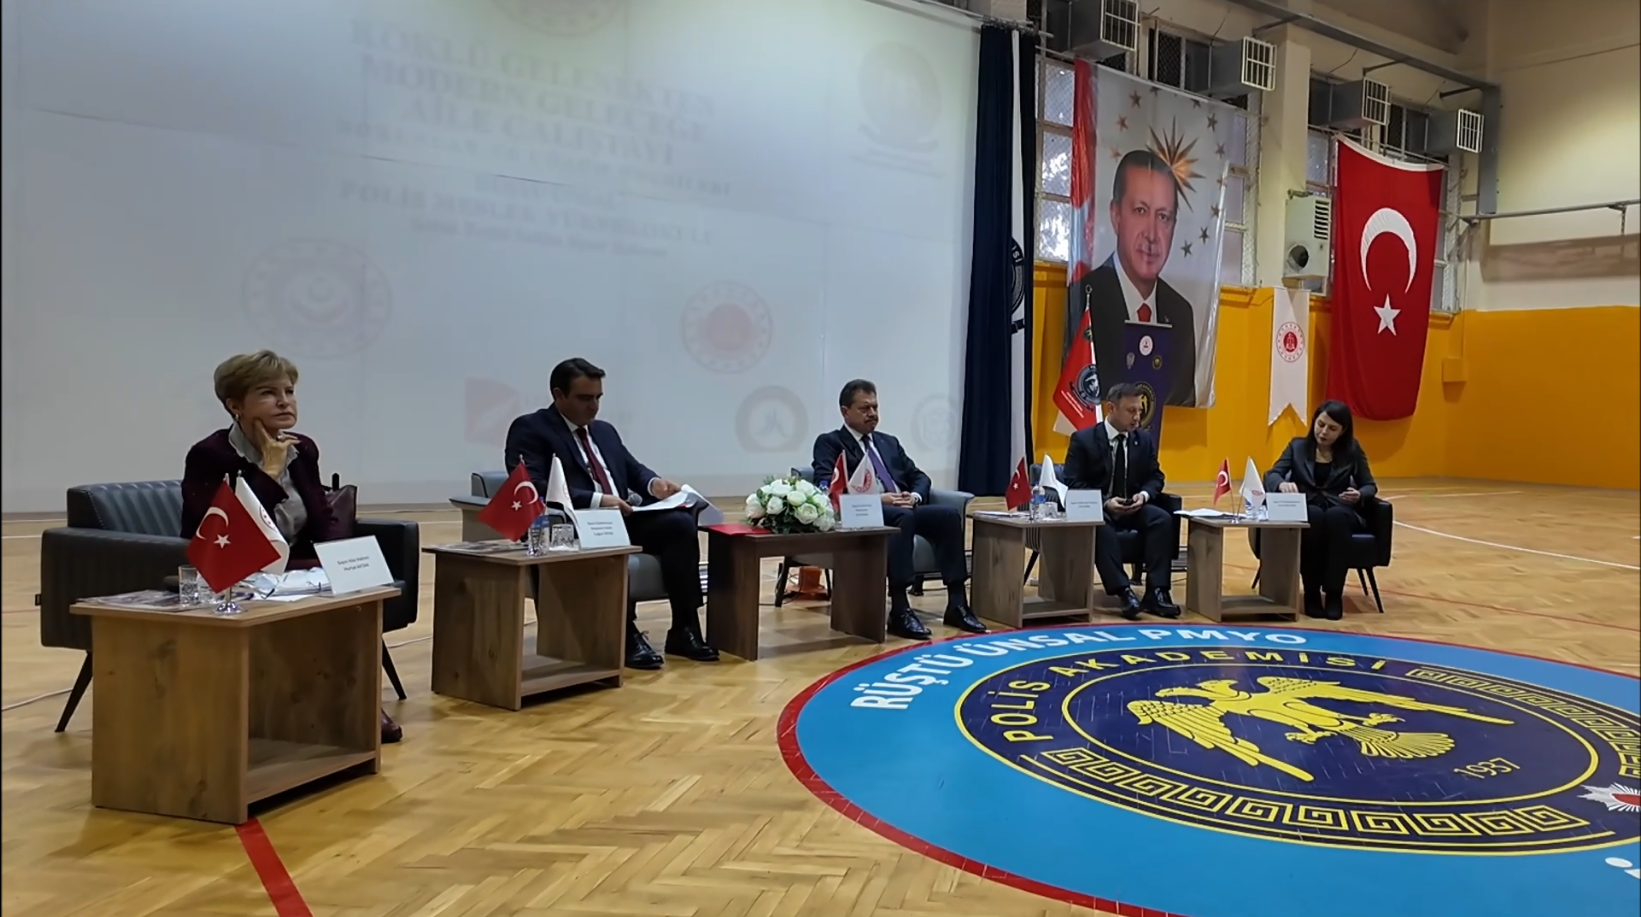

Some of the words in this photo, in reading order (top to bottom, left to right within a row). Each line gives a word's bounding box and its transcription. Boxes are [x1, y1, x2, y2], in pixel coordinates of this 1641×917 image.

[850, 654, 974, 709] RÜŞTÜ
[953, 628, 1136, 657] ÜNSAL
[1144, 628, 1307, 645] PMYO
[987, 680, 1055, 742] POLİS
[1048, 649, 1387, 677] AKADEMİSİ
[1453, 757, 1521, 779] 1937
